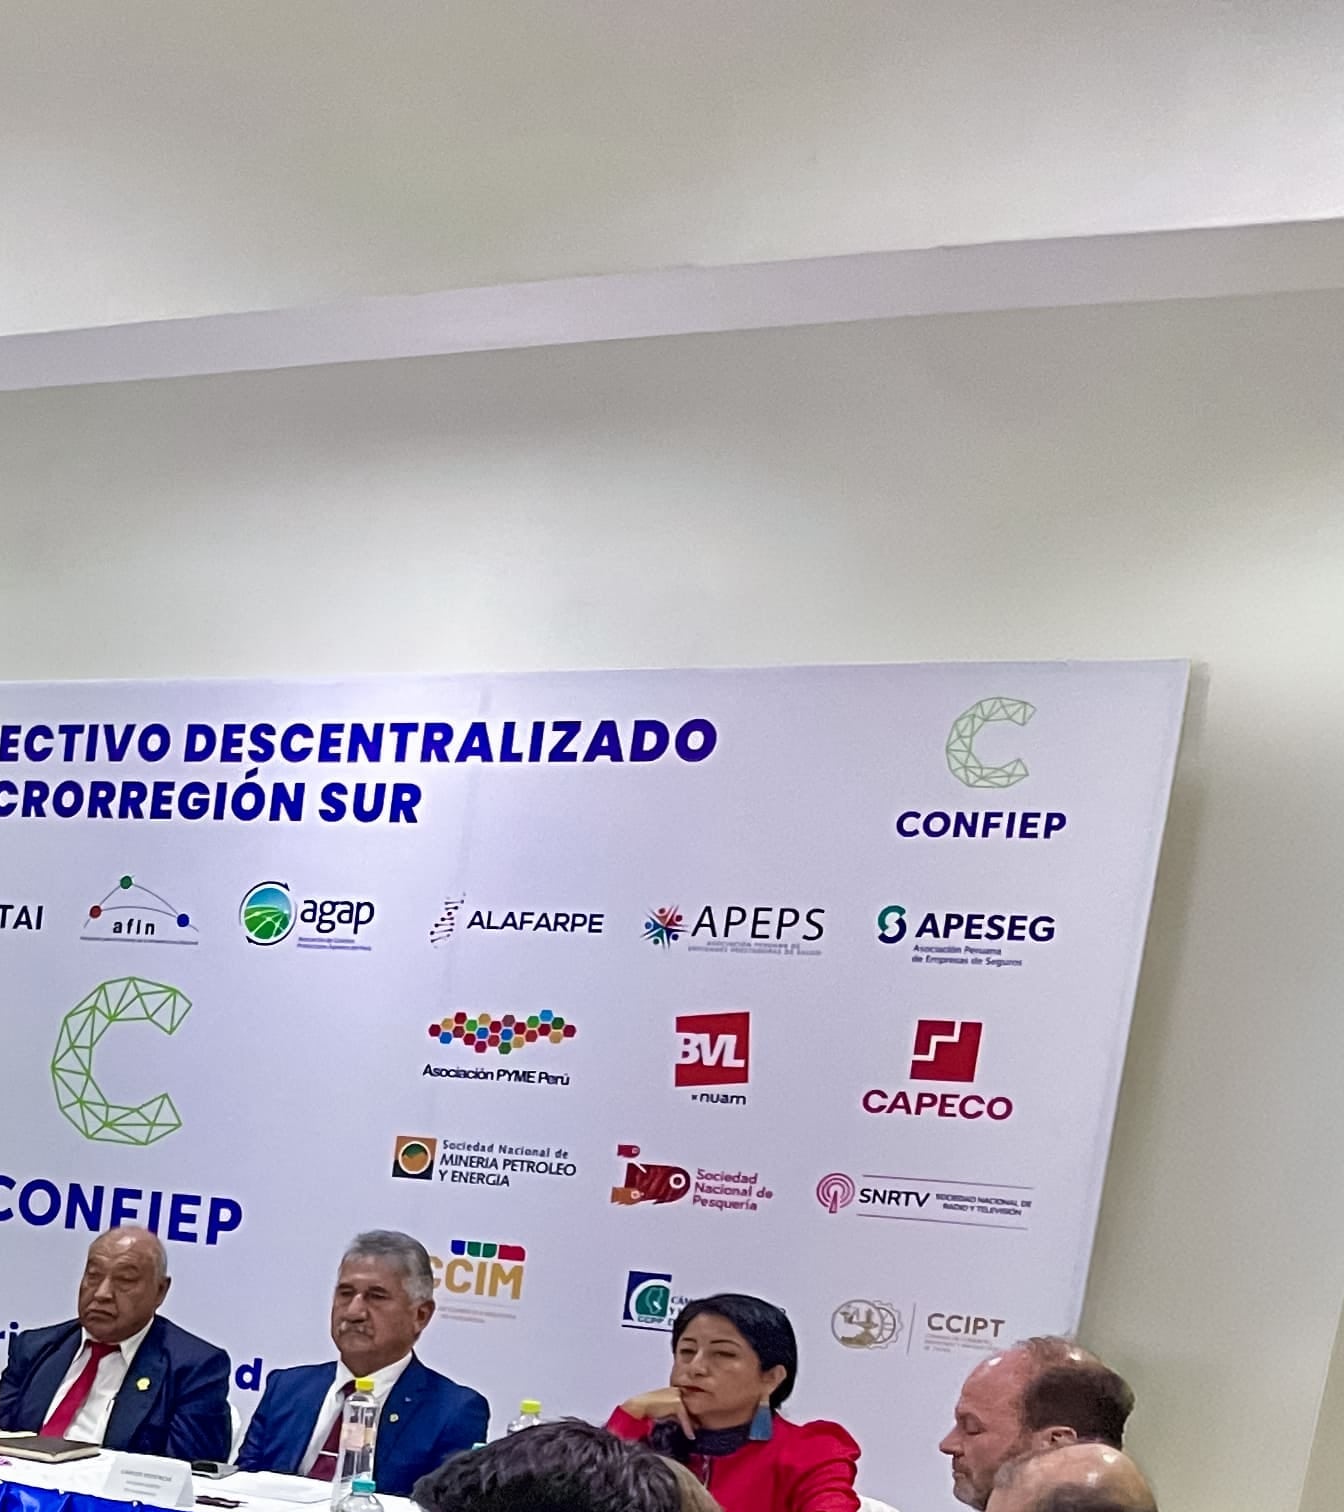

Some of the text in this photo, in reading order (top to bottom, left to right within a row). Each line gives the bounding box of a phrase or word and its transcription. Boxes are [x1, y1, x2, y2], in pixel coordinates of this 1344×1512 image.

[183, 718, 718, 763] DESCENTRALIZADO
[318, 782, 422, 823] SUR
[896, 811, 1067, 840] CONFIEP
[113, 919, 155, 936] afin
[300, 899, 375, 934] agap
[467, 911, 604, 934] ALAFARPE
[691, 905, 826, 942] APEPS
[915, 912, 1056, 942] APESEG
[675, 1032, 745, 1068] BVL
[422, 1064, 570, 1086] Asociación PYME Perú
[699, 1092, 747, 1105] nuam
[862, 1089, 1014, 1121] CAPECO
[443, 1139, 569, 1160] Sociedad Nacional de
[438, 1170, 448, 1182] Y
[502, 1159, 577, 1177] PETROLEO
[696, 1168, 758, 1184] Sociedad
[694, 1182, 773, 1199] Nacional de
[859, 1188, 930, 1208] SNRTV
[928, 1313, 1005, 1337] CCIPT
